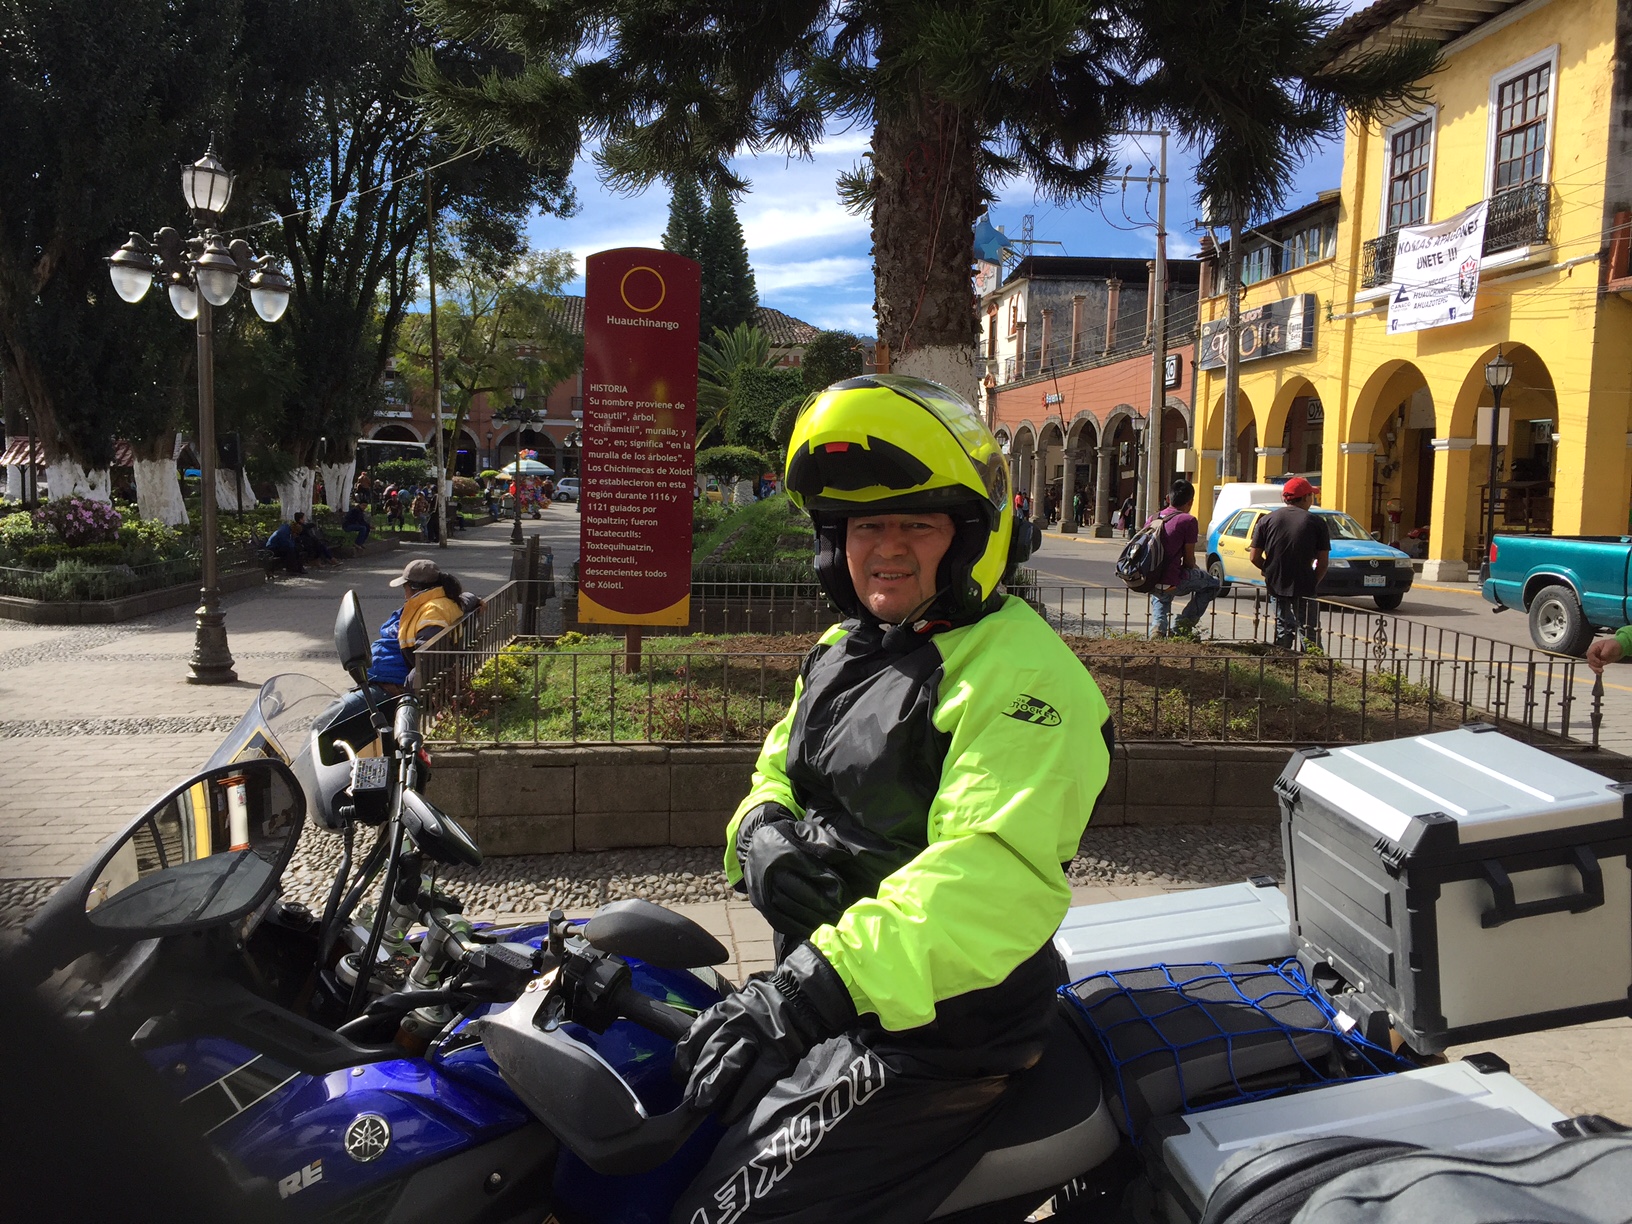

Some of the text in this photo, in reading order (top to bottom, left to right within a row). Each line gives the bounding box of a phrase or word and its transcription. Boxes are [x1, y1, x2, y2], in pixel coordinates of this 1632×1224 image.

[1416, 252, 1444, 270] UNETE
[606, 315, 680, 331] Huauchinango
[589, 384, 628, 393] HISTORIA
[589, 397, 600, 405] Su
[601, 398, 634, 407] nombre
[635, 400, 673, 409] proviene
[632, 412, 657, 423] árbol,
[645, 427, 679, 437] muralla;
[681, 429, 687, 438] y
[614, 439, 628, 448] en;
[629, 439, 664, 449] significa
[683, 441, 691, 450] la
[588, 451, 620, 459] muralla
[621, 452, 633, 460] de
[634, 452, 646, 461] los
[587, 464, 693, 476] Los Chichimecas de Xolotl
[588, 477, 598, 485] se
[599, 477, 655, 488] establecieron
[669, 481, 687, 489] esta
[587, 490, 678, 503] región durante 1116 y
[588, 503, 657, 514] 1121 guiados por
[586, 515, 658, 526] Nopaltzin; fueron
[585, 541, 654, 553] Toxtequihuatzin,
[586, 554, 638, 565] Xochitecutli,
[585, 567, 668, 578] descencientes todos
[585, 581, 624, 590] de Xólotl.
